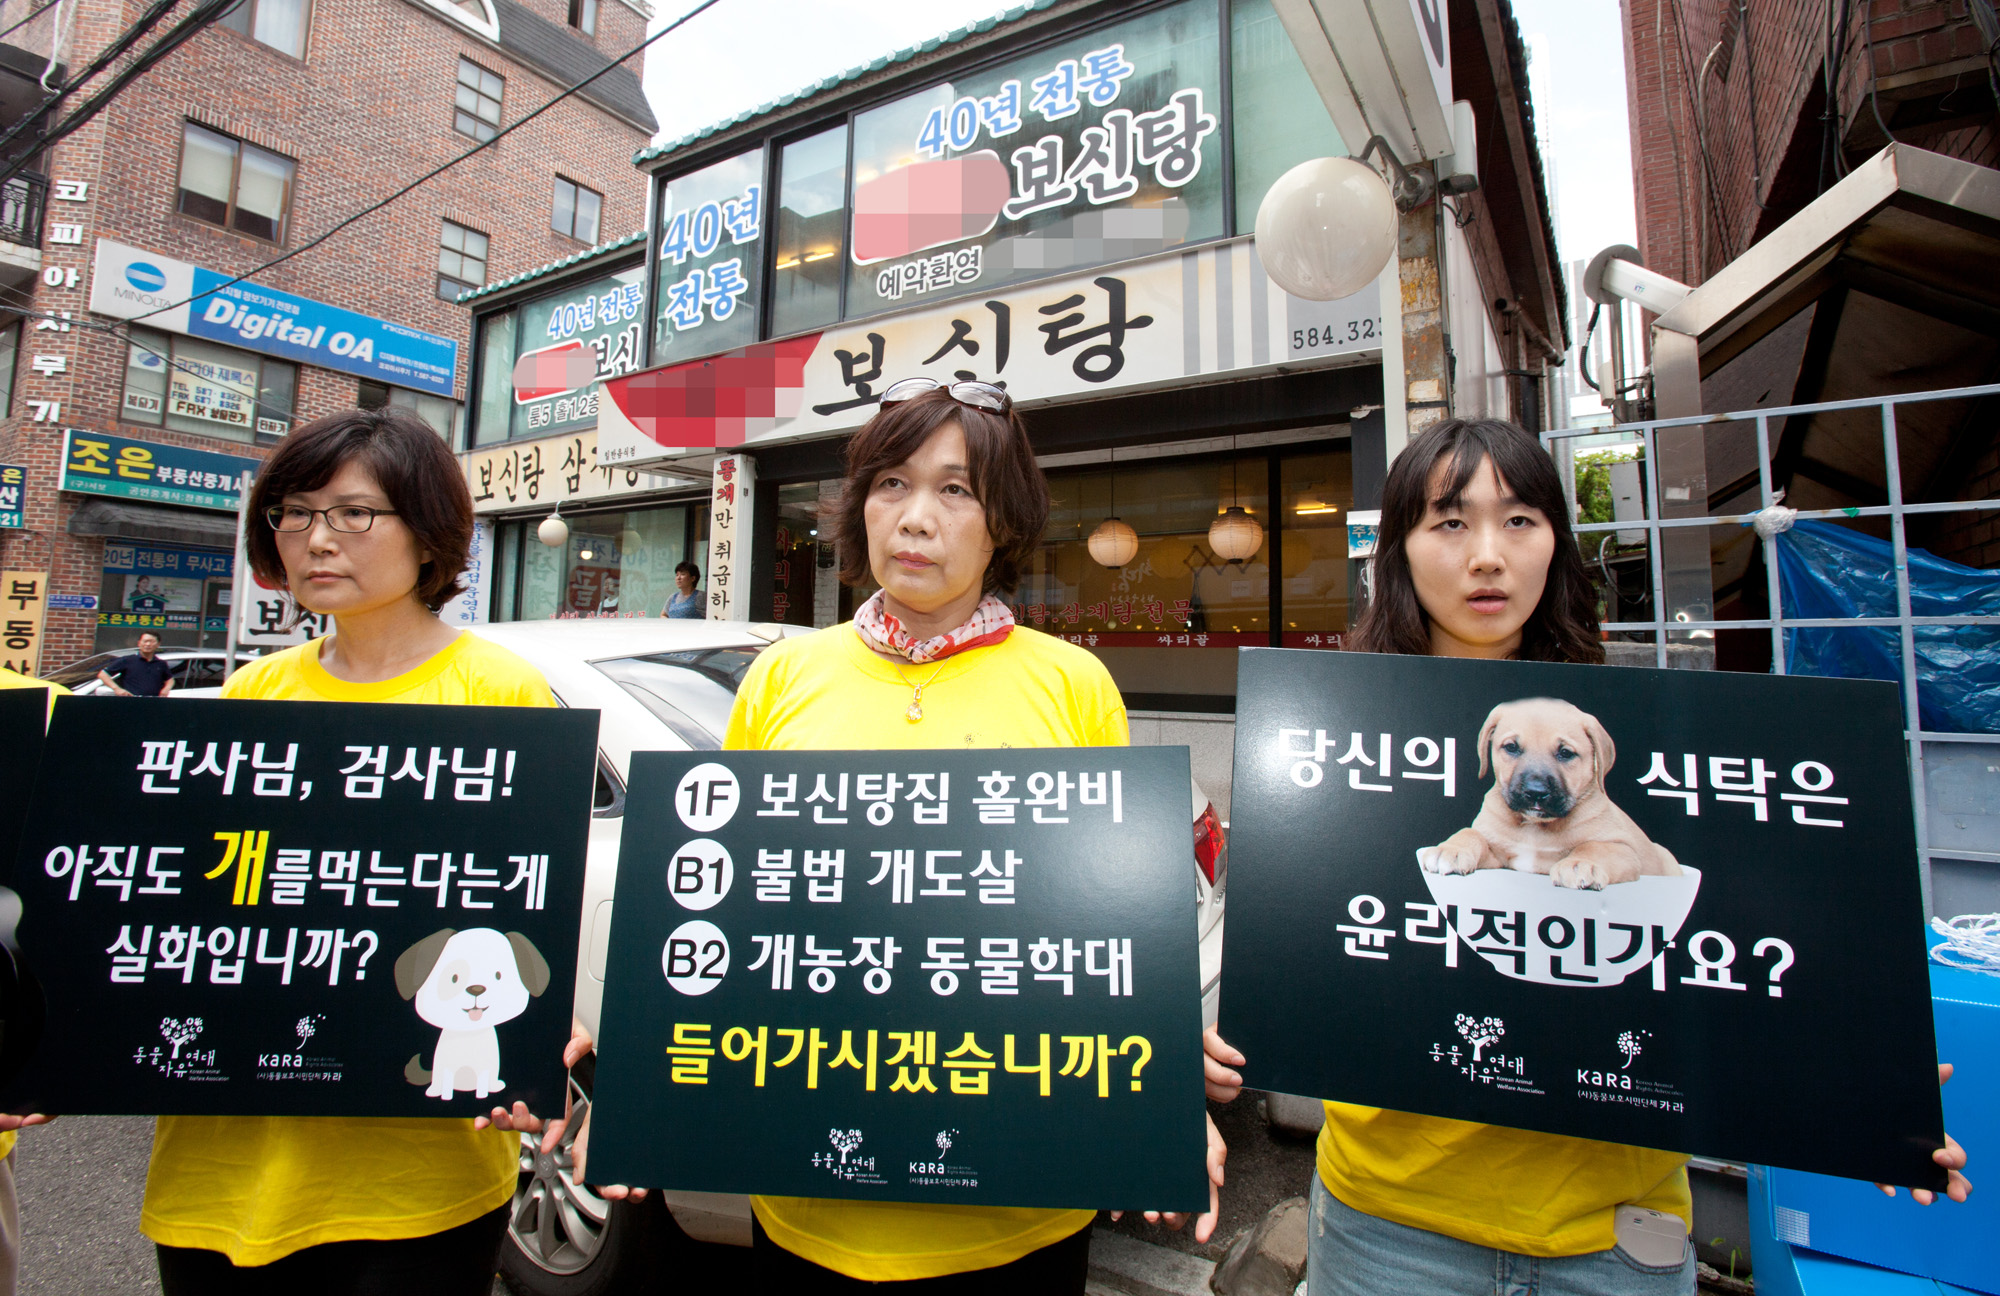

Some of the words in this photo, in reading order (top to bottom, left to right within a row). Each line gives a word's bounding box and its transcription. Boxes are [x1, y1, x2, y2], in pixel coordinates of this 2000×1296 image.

[919, 81, 1021, 156] 40년
[1031, 46, 1133, 121] 전통
[1004, 90, 1214, 218] 보신탕
[661, 184, 760, 264] 40년
[114, 287, 172, 308] MINOLTA
[665, 258, 747, 330] 전통
[877, 247, 981, 298] 예약환영
[203, 297, 322, 350] Digital
[328, 331, 375, 363] OA
[547, 295, 596, 340] 40년
[598, 282, 643, 325] 전통
[171, 391, 189, 400] FAX
[173, 382, 189, 392] TEL
[177, 401, 206, 416] FAX
[528, 403, 551, 428] 룸5
[68, 438, 155, 481] 조은
[474, 446, 545, 503] 보신탕
[137, 551, 179, 570] 전통의
[186, 555, 226, 573] 무사고
[136, 740, 313, 800] 판사님,
[339, 744, 517, 802] 검사님!
[682, 780, 732, 817] 1F
[756, 772, 950, 824] 보신탕집
[972, 770, 1124, 824] 홀완비
[1277, 727, 1457, 798] 당신의
[1636, 751, 1849, 828] 식탁은
[44, 844, 185, 902] 아직도
[204, 830, 549, 910] 개를먹는다는게
[674, 856, 727, 894] B1
[751, 849, 845, 903] 불법
[867, 849, 1023, 904] 개도살
[106, 924, 378, 986] 실화입니까?
[667, 939, 726, 979] B2
[747, 934, 902, 994] 개농장
[921, 936, 1133, 996] 동물학대
[1336, 893, 1795, 998] 윤리적인가요?
[666, 1023, 1153, 1098] 들어가시겠습니까?
[1496, 1084, 1516, 1092] Welfare
[1517, 1087, 1545, 1095] Association
